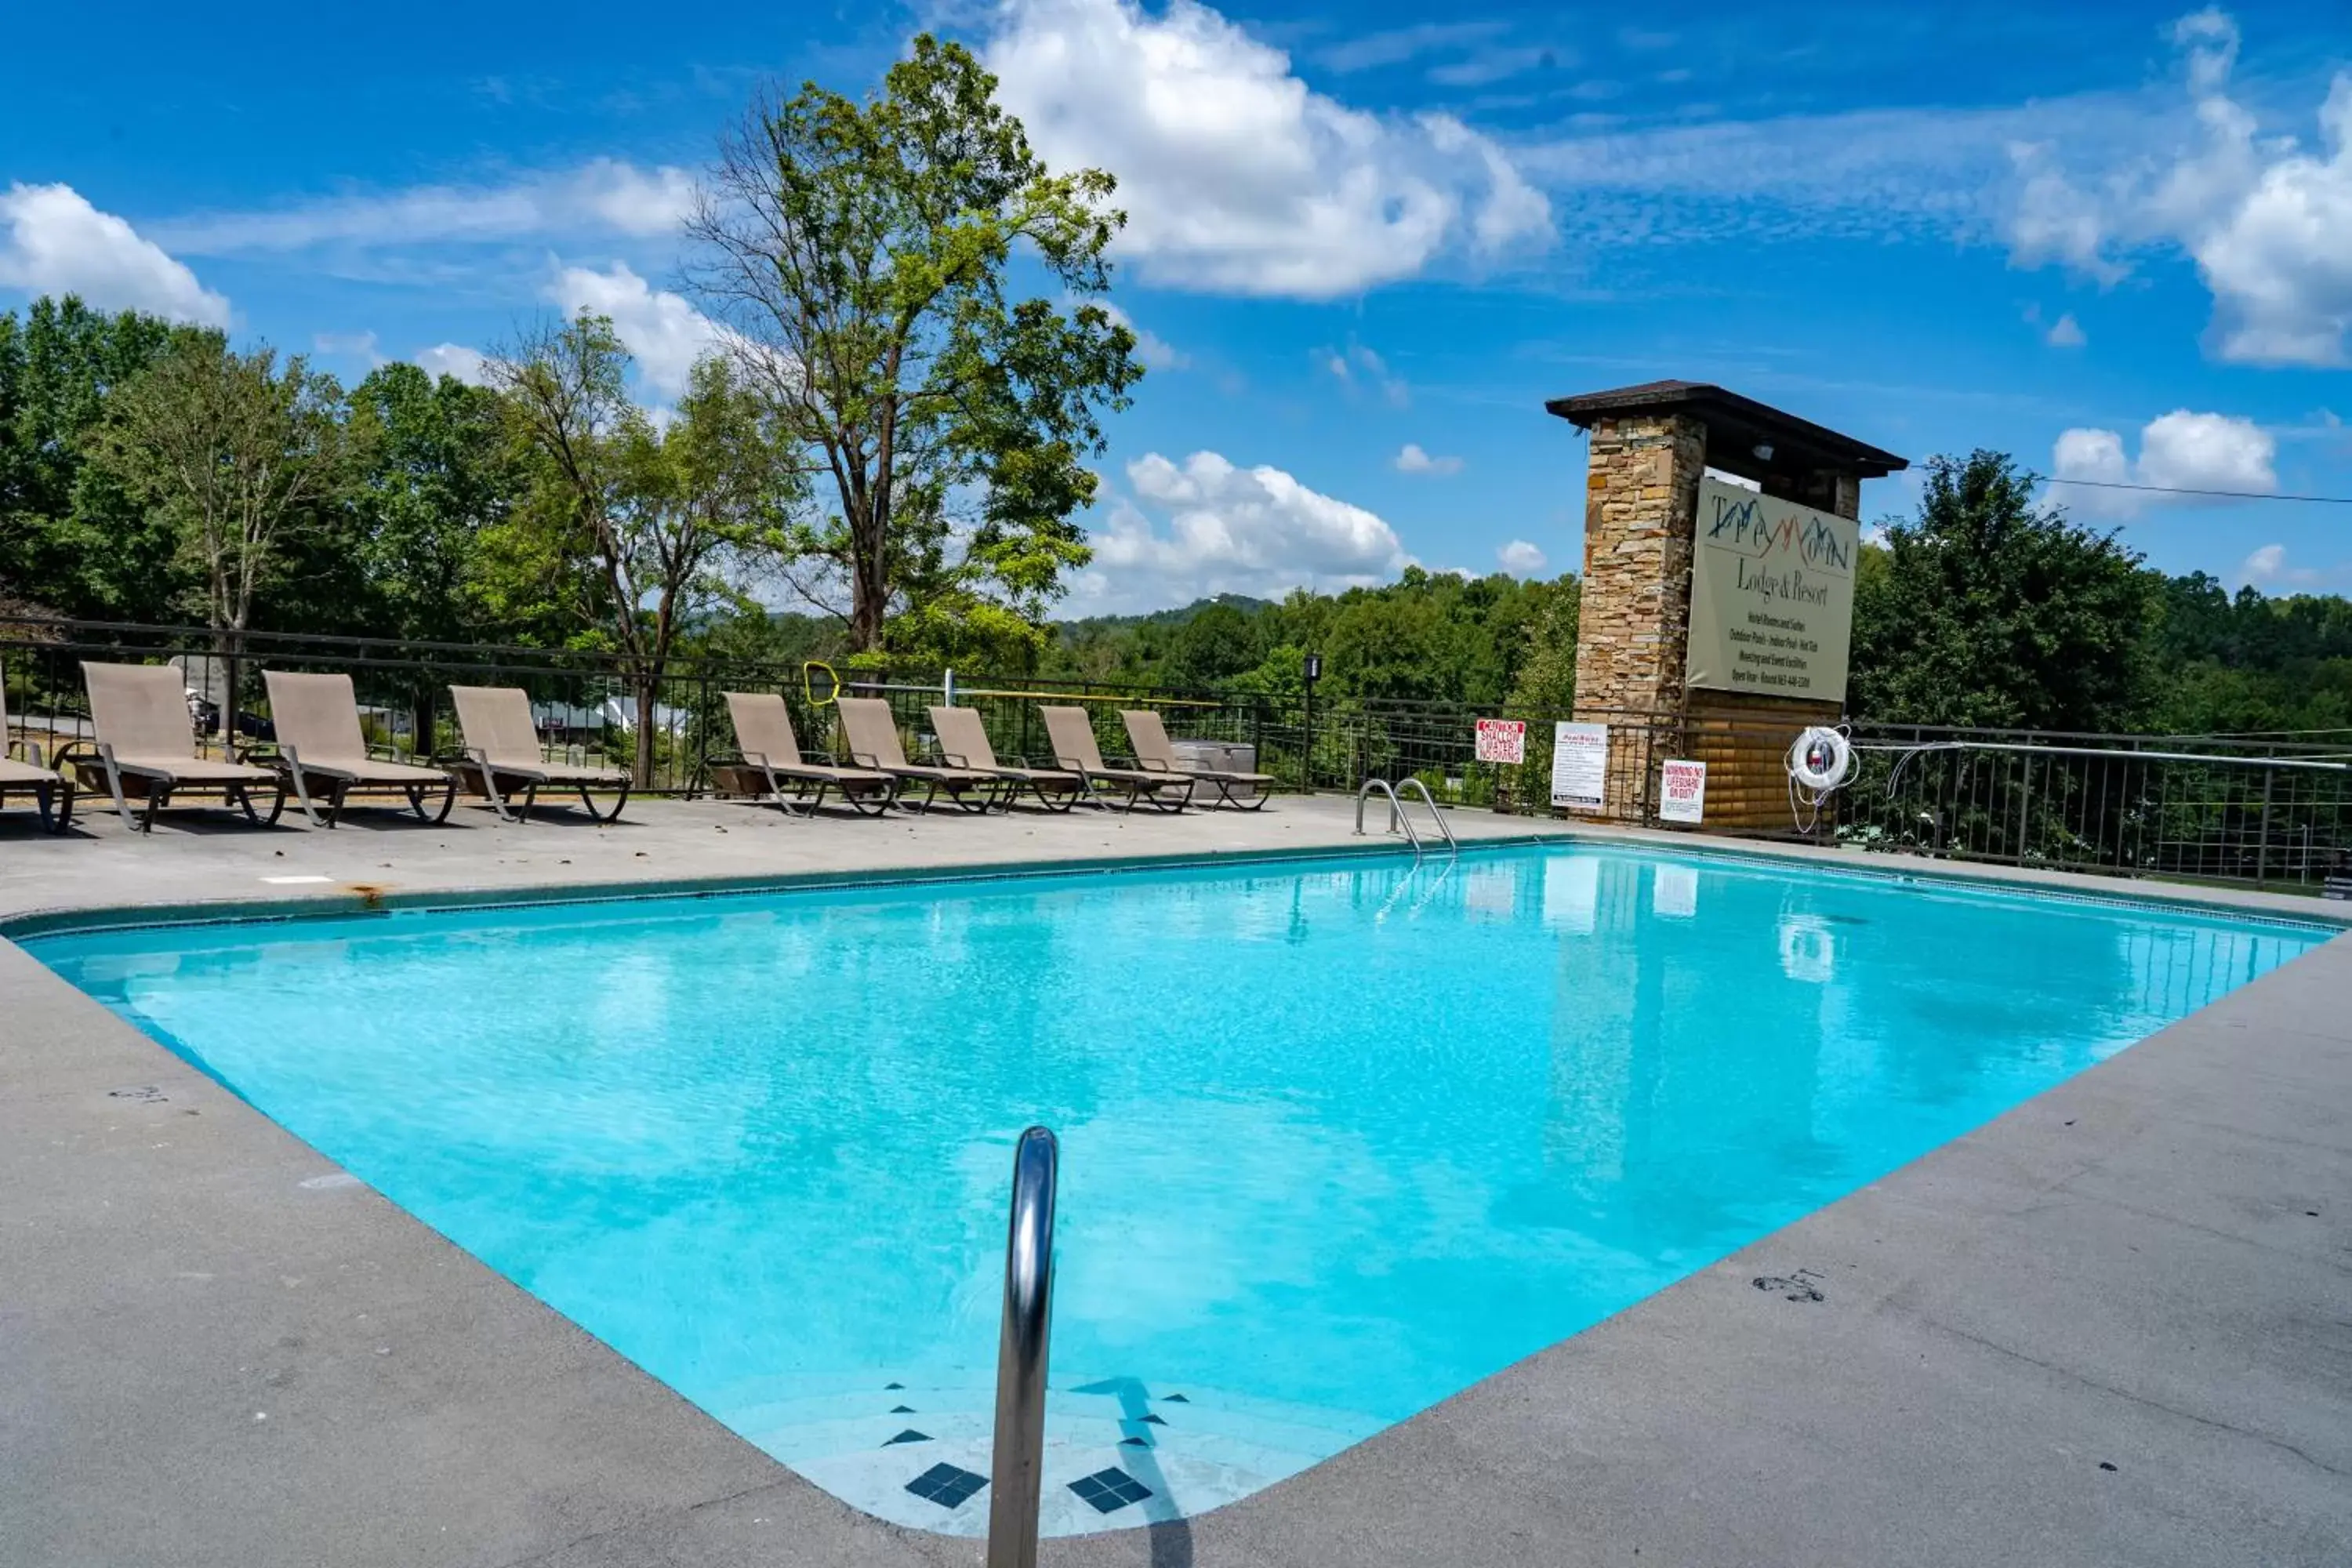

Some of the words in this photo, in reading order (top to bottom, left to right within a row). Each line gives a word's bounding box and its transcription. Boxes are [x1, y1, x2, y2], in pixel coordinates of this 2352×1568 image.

[1737, 557, 1778, 604] Lodge
[1780, 573, 1789, 600] &
[1792, 570, 1828, 608] Resort
[1730, 628, 1751, 642] Outdoor
[1481, 731, 1519, 743] SHALLOW
[1486, 741, 1514, 753] WATER
[1480, 750, 1491, 759] NO
[1493, 751, 1521, 762] DIVING
[1665, 765, 1693, 776] WARNING
[1694, 767, 1704, 778] NO
[1667, 775, 1700, 789] LIFEGUARD
[1670, 787, 1678, 797] ON
[1679, 788, 1695, 799] DUTY
